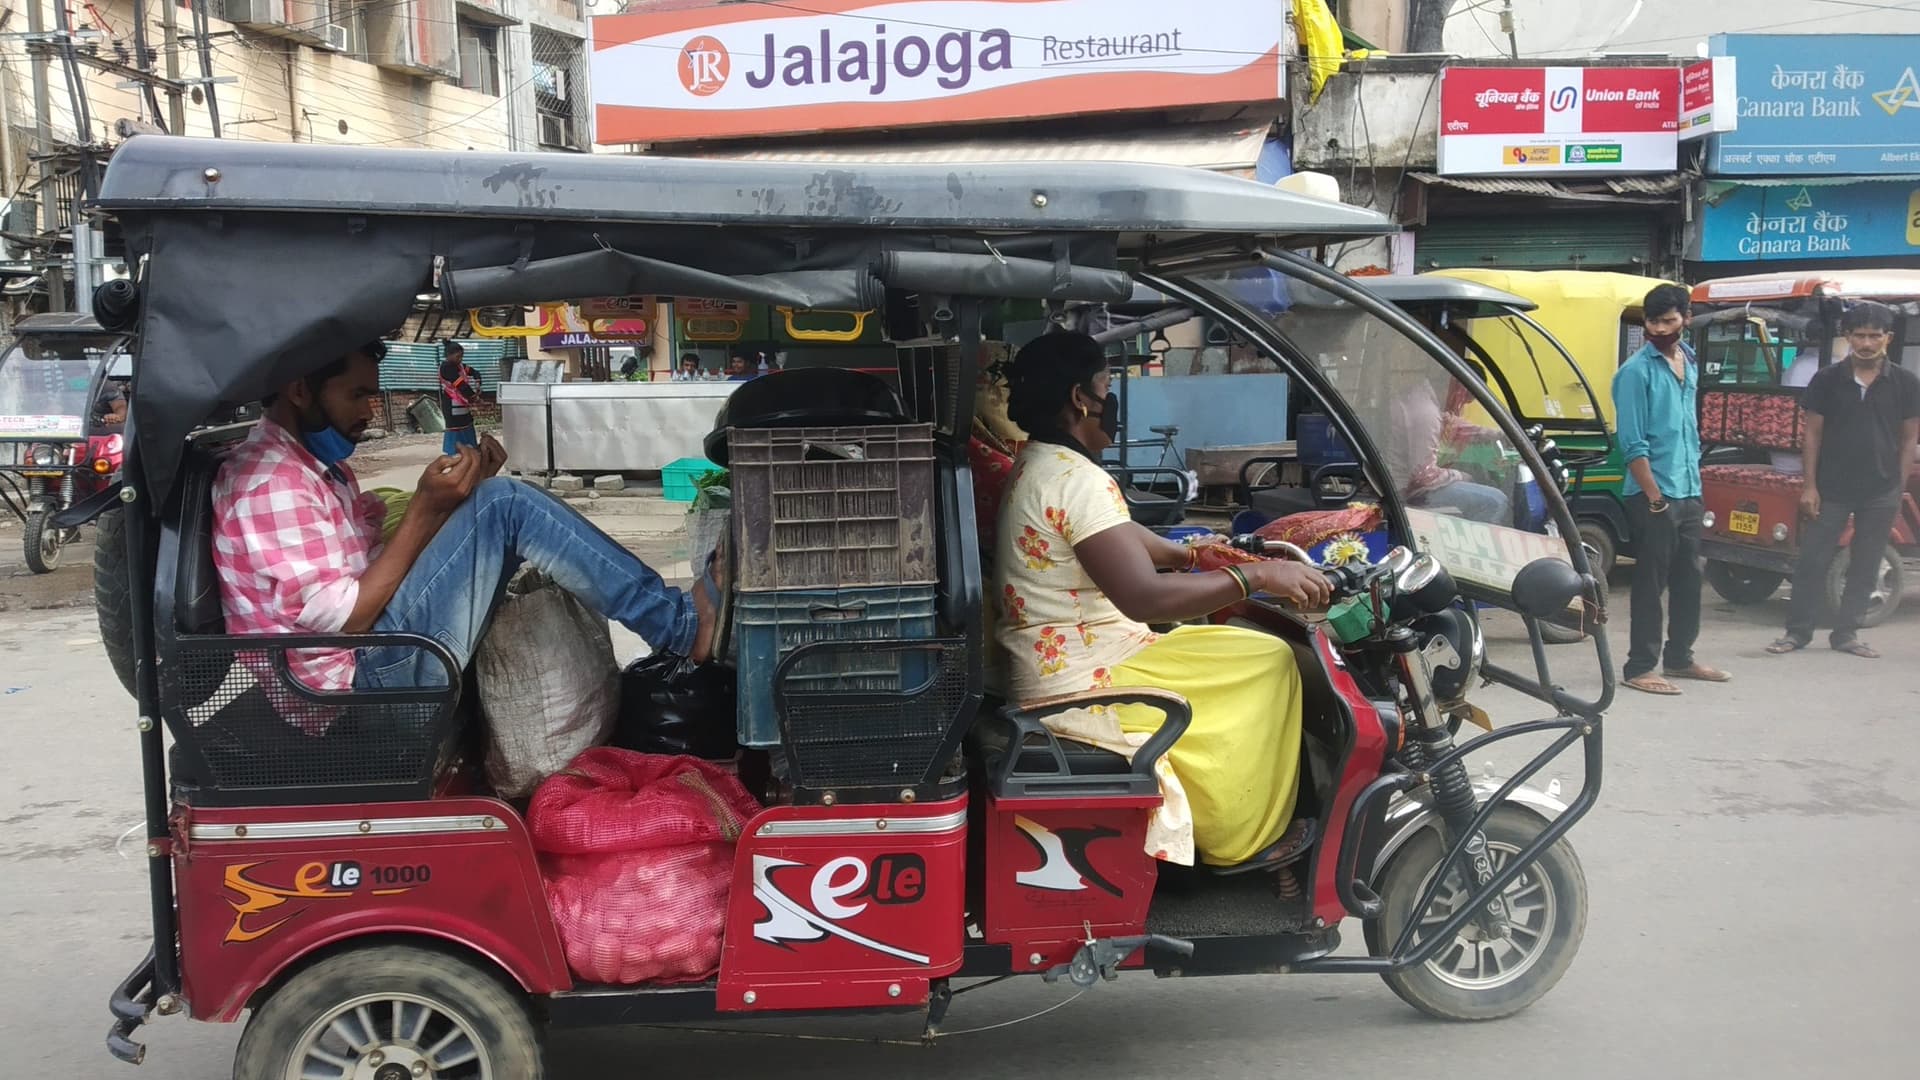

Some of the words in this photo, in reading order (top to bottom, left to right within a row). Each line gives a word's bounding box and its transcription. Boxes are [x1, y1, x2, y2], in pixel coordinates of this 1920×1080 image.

[745, 24, 1013, 95] Jalajoga
[1042, 28, 1182, 61] Restaurant
[1771, 64, 1826, 90] केनरा
[1832, 64, 1864, 90] बैंक
[1475, 89, 1518, 108] यूनियन
[1520, 88, 1540, 102] बैंक
[1586, 89, 1624, 102] Union
[1626, 88, 1660, 101] Bank
[1643, 102, 1660, 110] India
[1736, 96, 1804, 118] Canara
[1812, 96, 1861, 118] Bank
[1880, 152, 1908, 162] Albert
[1746, 212, 1806, 235] केनरा
[1813, 210, 1848, 233] बैंक
[1738, 237, 1800, 254] Canara
[1807, 235, 1851, 252] Bank
[370, 865, 431, 884] 1000
[810, 856, 922, 919] ele
